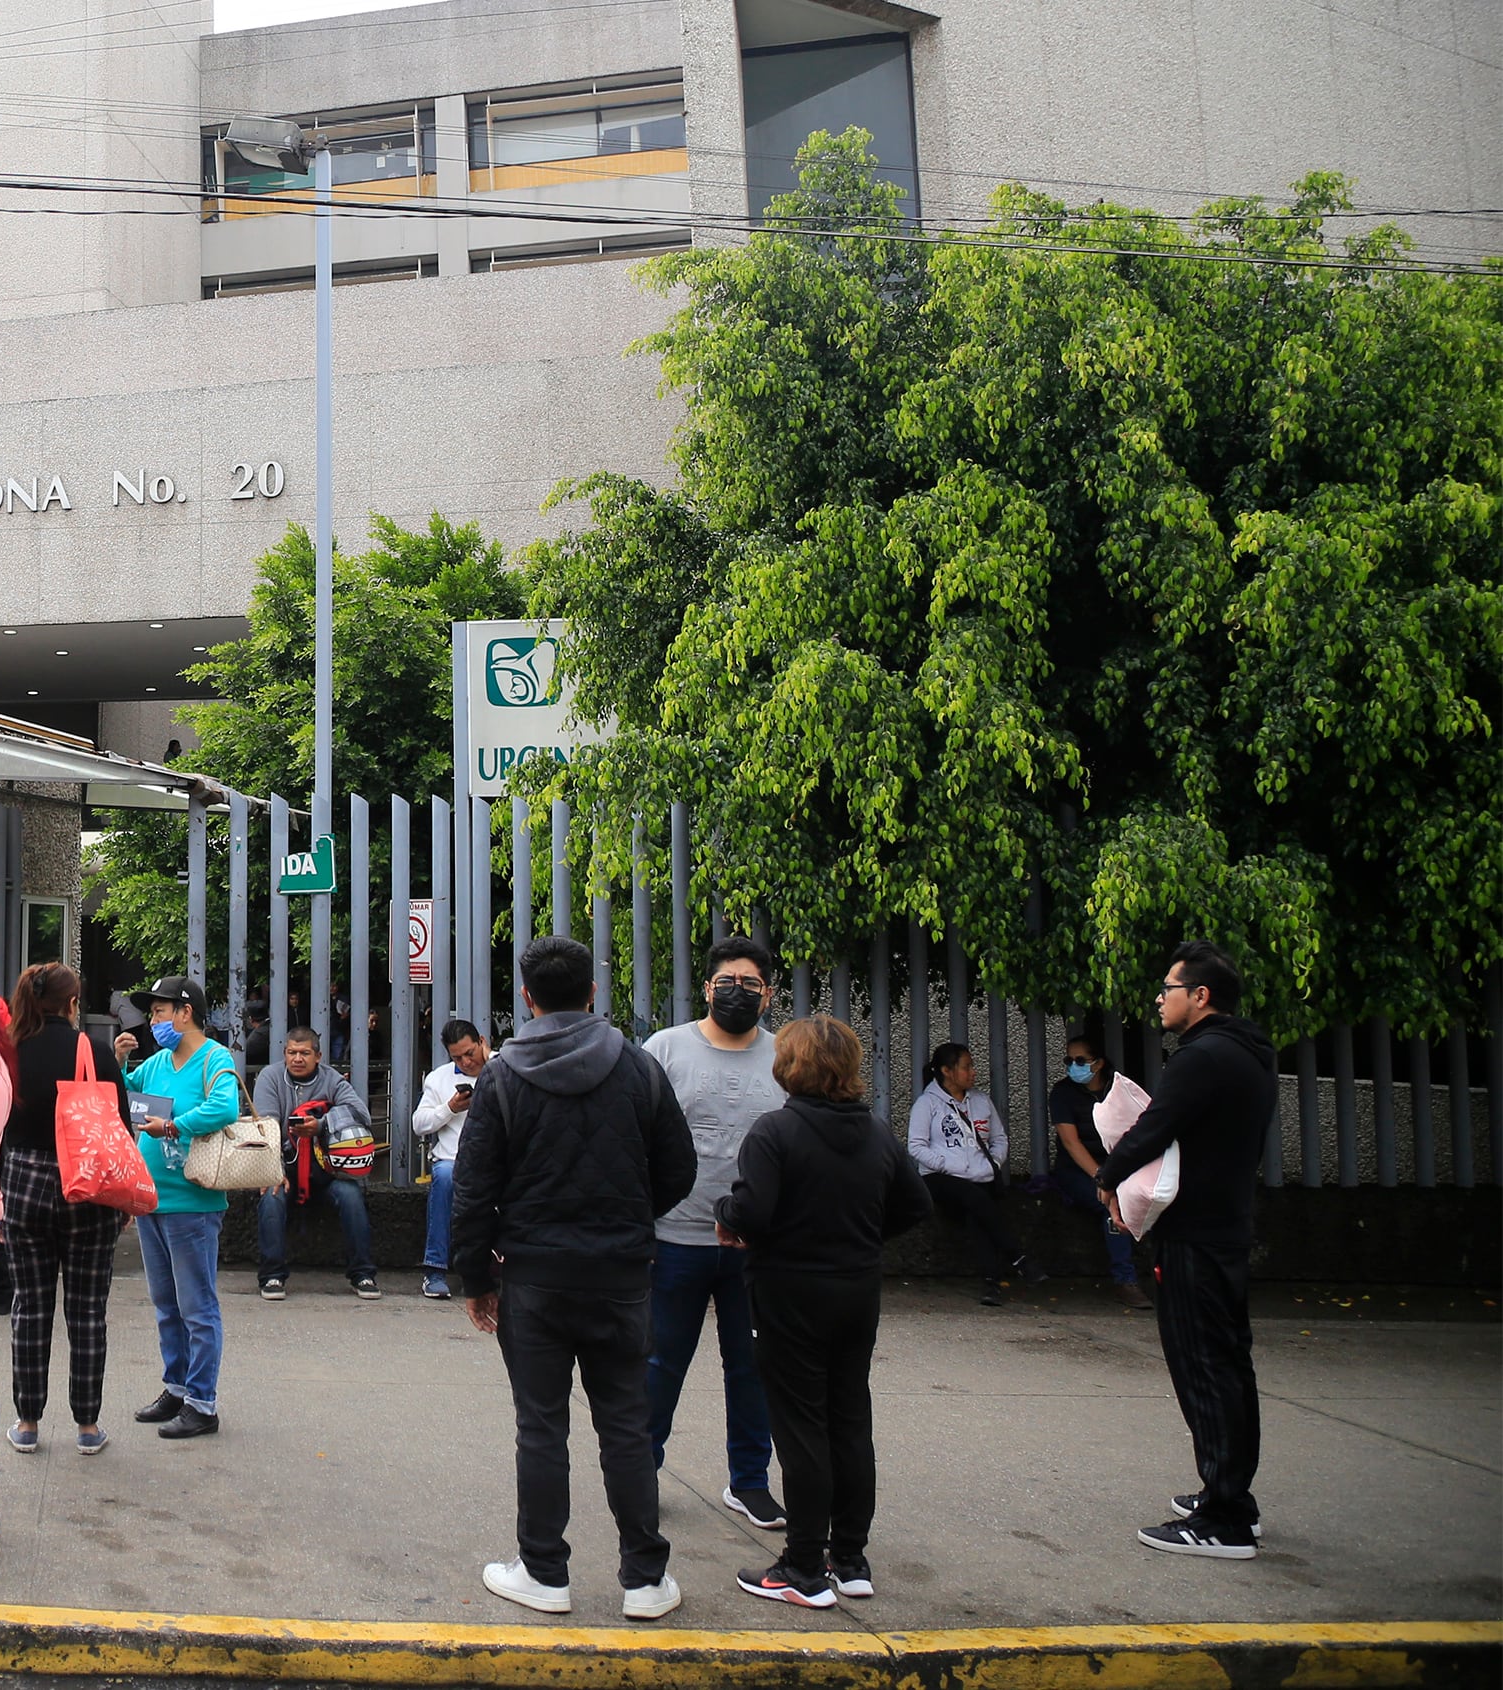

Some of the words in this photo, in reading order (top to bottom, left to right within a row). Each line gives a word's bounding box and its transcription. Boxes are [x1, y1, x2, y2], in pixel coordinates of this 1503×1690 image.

[112, 468, 187, 506] No.
[230, 461, 285, 500] 20
[409, 903, 430, 911] UMAR
